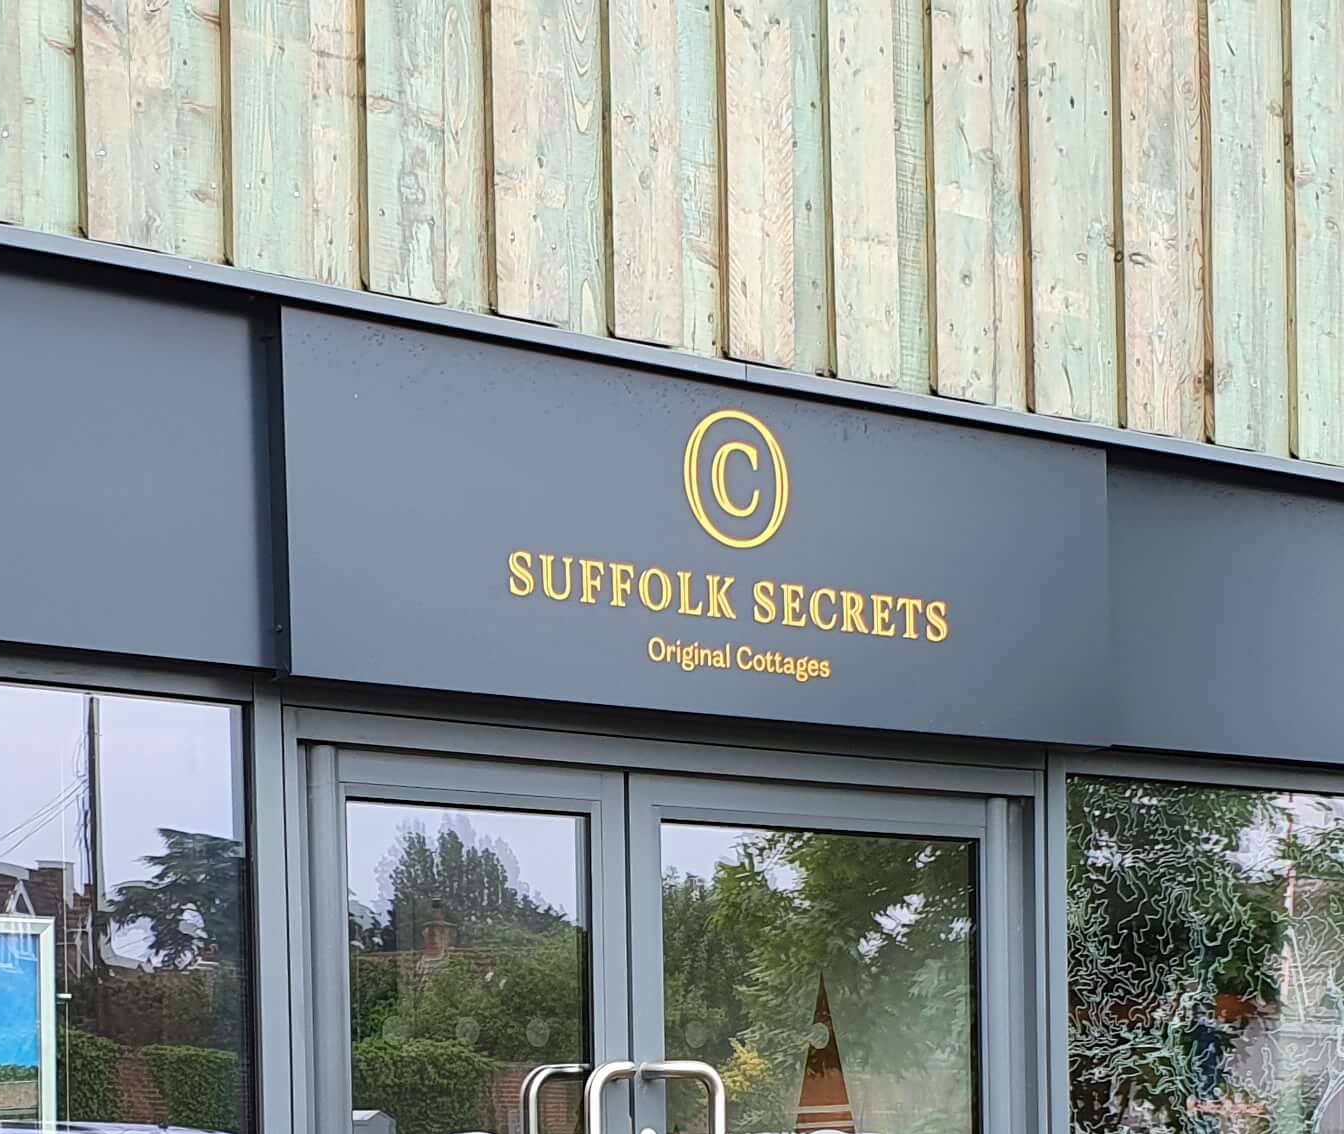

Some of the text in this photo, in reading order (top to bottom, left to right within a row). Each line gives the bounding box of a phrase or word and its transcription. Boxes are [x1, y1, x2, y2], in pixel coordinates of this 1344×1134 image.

[507, 550, 950, 643] SUFFOLK SECRETS
[648, 636, 832, 683] Original Cottages
